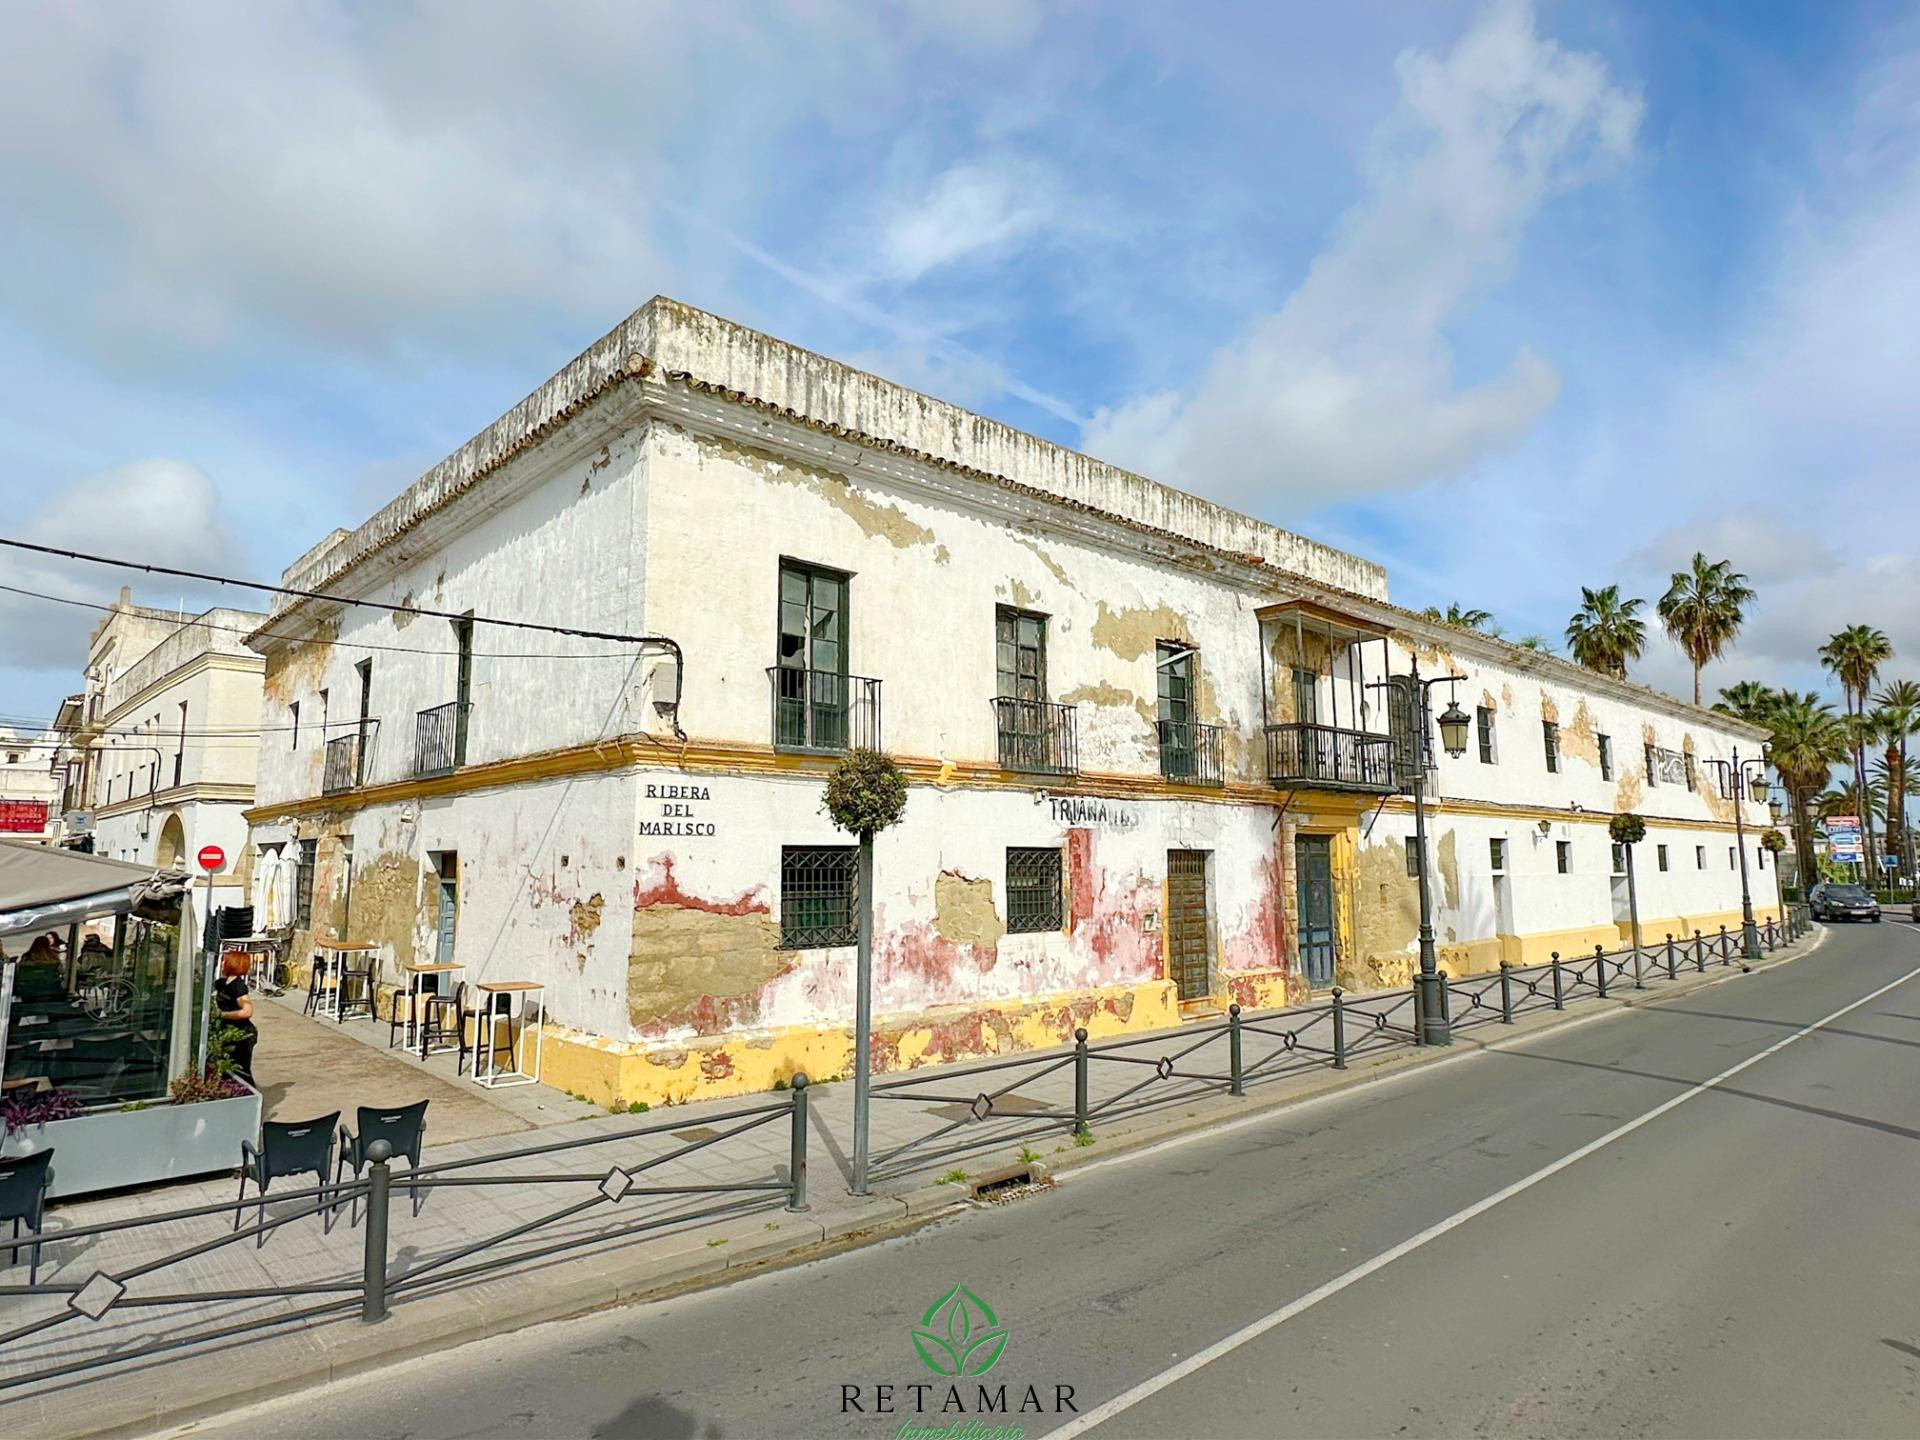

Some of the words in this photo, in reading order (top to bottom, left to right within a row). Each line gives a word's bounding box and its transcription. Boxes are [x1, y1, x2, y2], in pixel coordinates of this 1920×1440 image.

[645, 784, 711, 801] RIBERA
[661, 803, 694, 818] DEL
[1048, 797, 1107, 822] TRIANA
[638, 821, 716, 837] MARISCO
